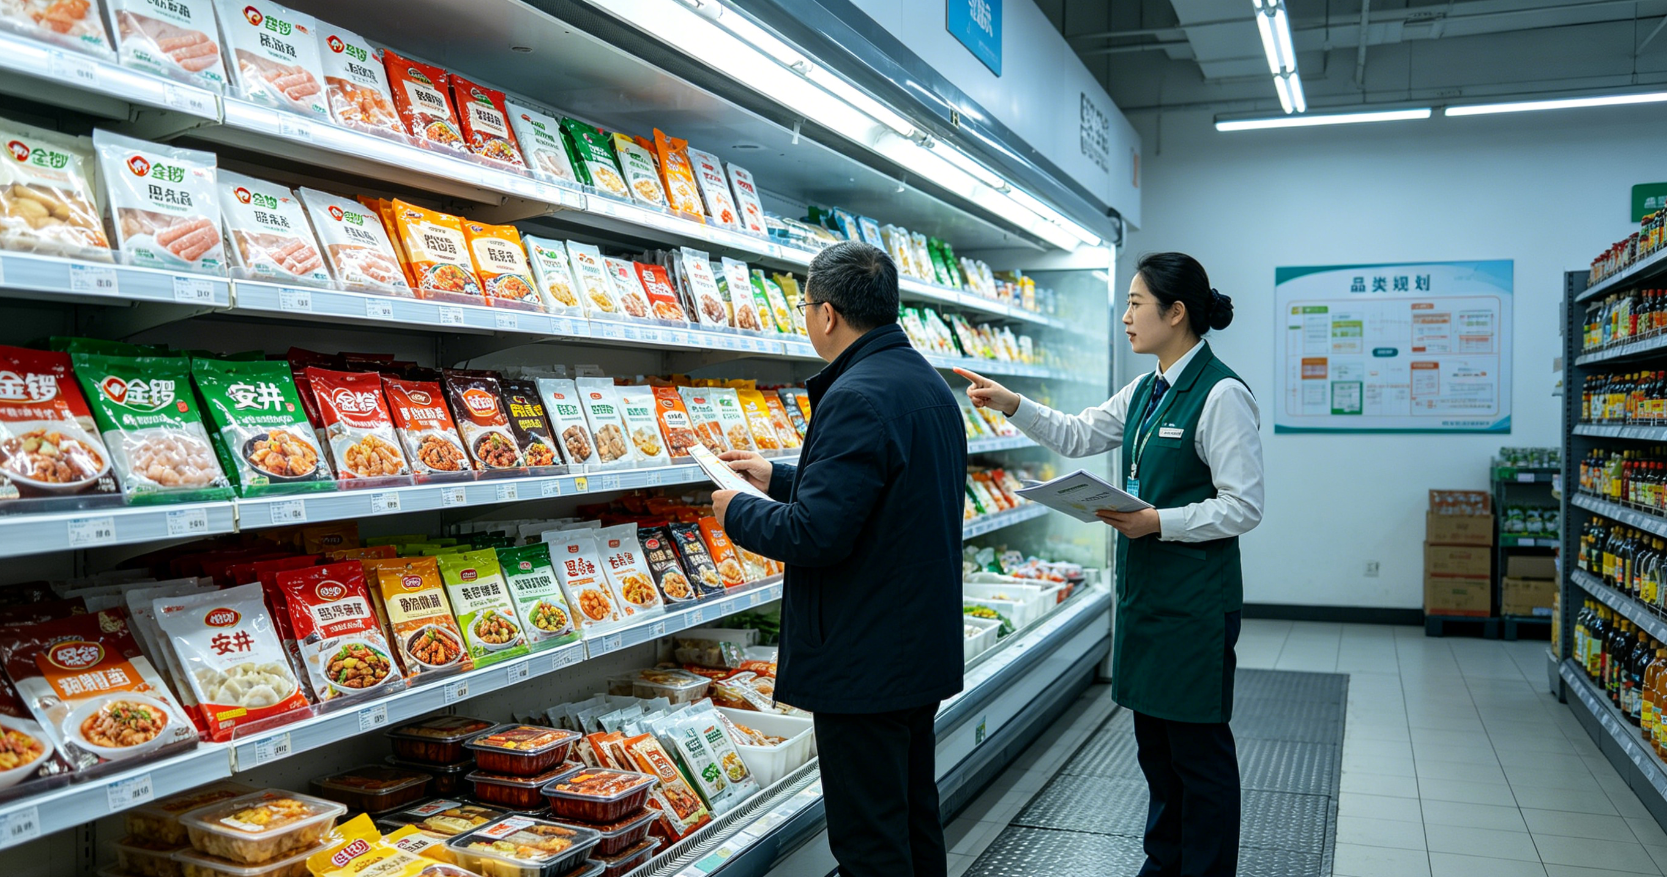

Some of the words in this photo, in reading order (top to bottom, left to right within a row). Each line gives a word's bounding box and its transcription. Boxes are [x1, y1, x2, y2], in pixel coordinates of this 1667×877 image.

[1350, 274, 1430, 293] 品类规划
[127, 379, 175, 405] 金锣
[227, 381, 285, 411] 安井
[210, 630, 254, 656] 安井
